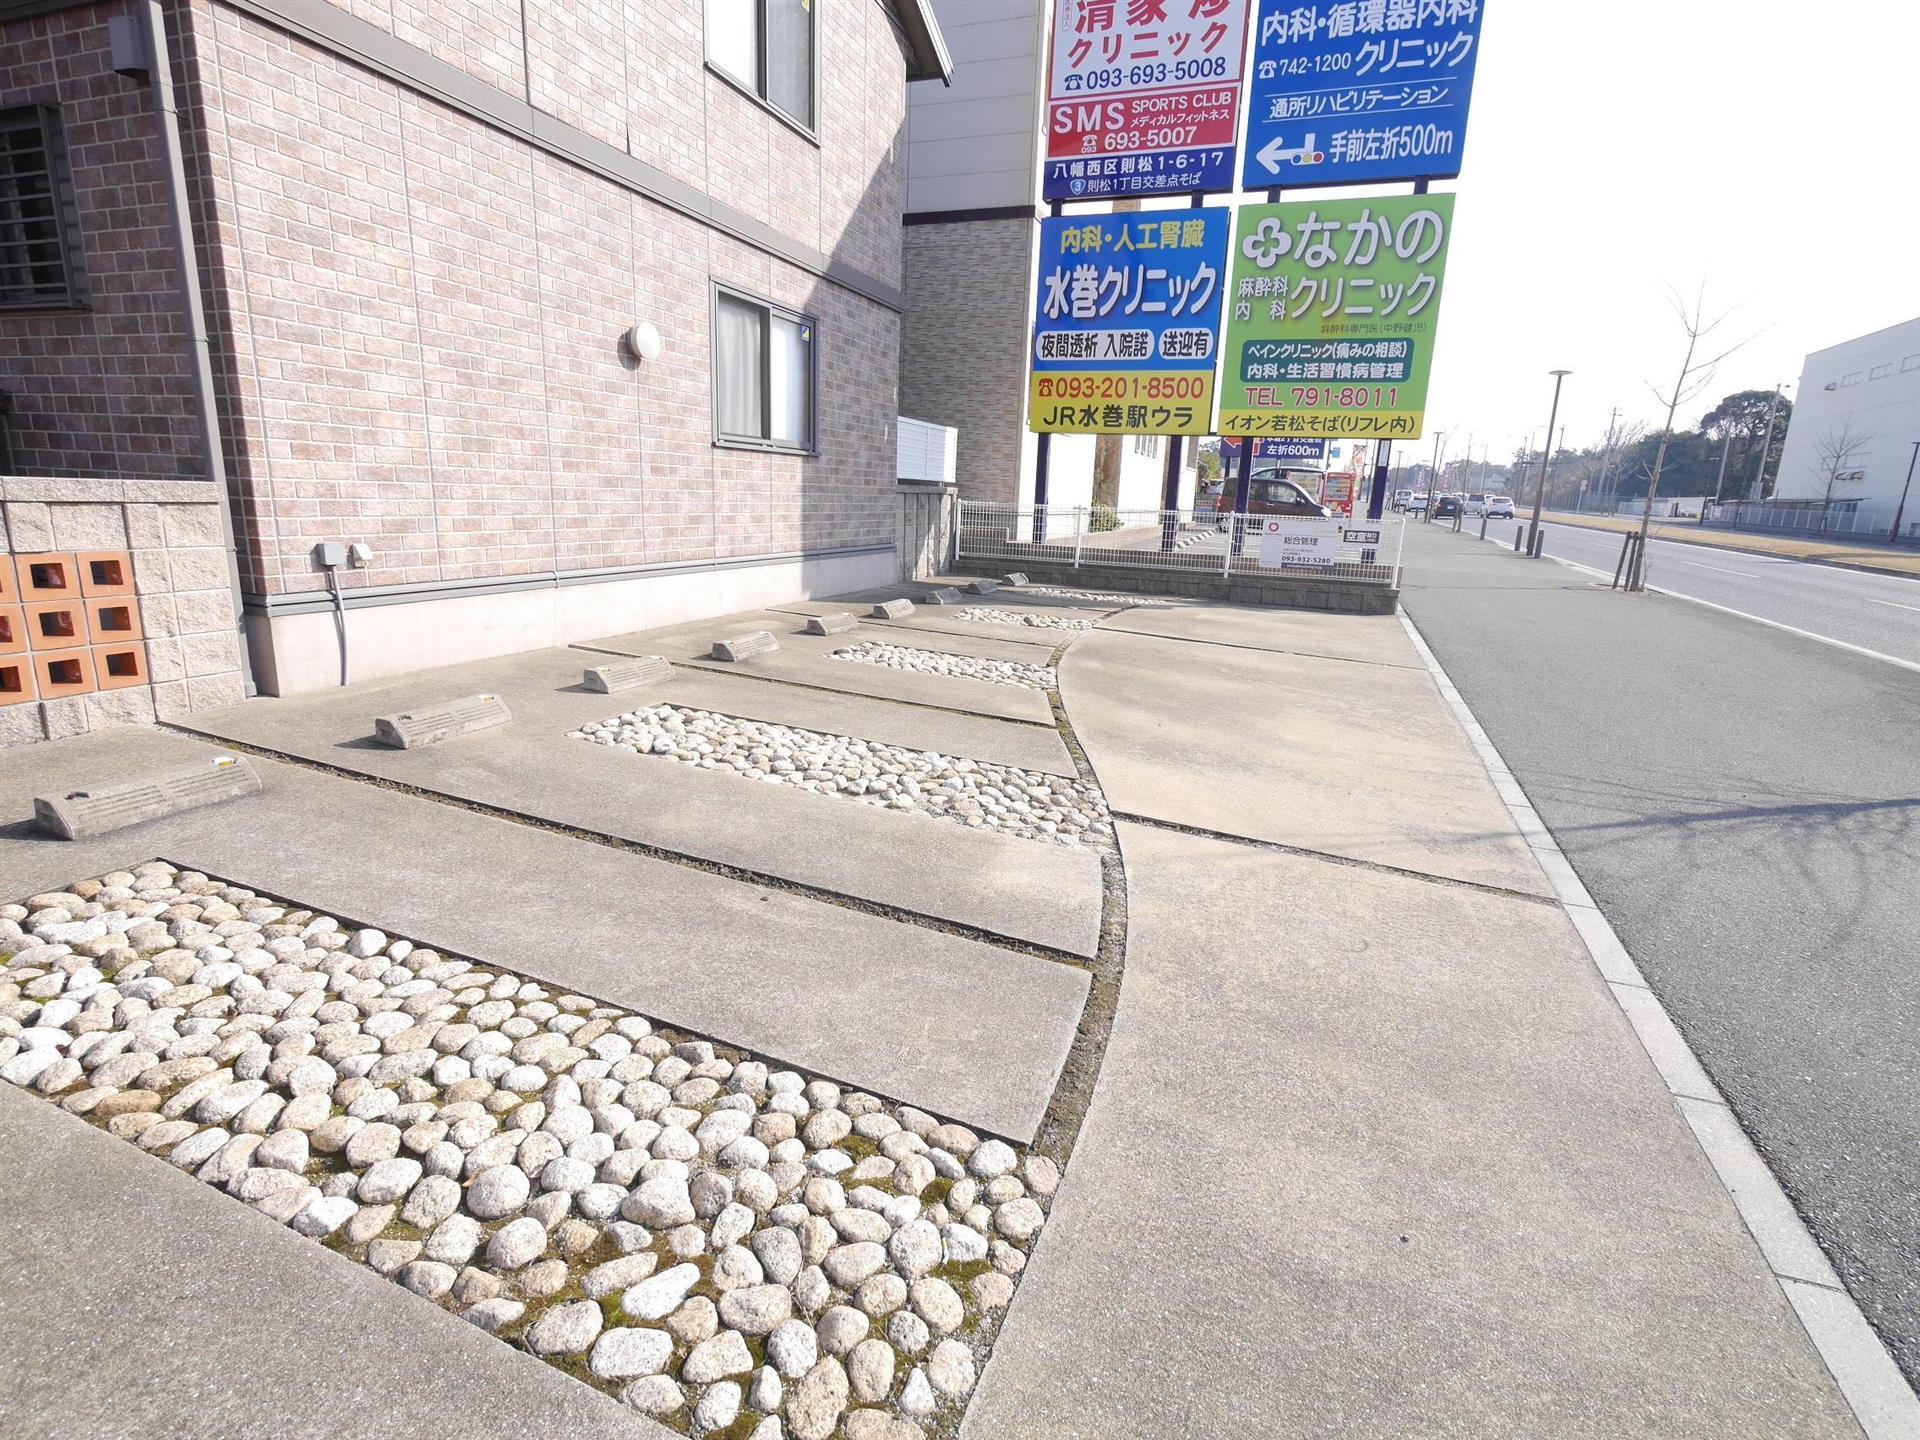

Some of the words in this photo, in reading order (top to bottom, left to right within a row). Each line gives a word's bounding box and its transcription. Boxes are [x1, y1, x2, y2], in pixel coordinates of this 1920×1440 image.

[1261, 0, 1478, 46] 内科・循環器内科
[1068, 22, 1229, 68] クリニック
[1279, 52, 1351, 75] 742-1200
[1355, 31, 1473, 76] クリニック
[1087, 57, 1226, 89] 093-693-5008
[1131, 96, 1187, 113] SPORTS
[1193, 92, 1232, 107] CLUB
[1269, 85, 1449, 119] 通所リハビリテーション
[1054, 103, 1125, 134] SMS
[1130, 109, 1230, 128] メディカルフィットネス
[1104, 126, 1197, 150] 693-5007
[1330, 123, 1453, 163] 手前左折500m
[1087, 171, 1202, 192] 則松1丁目交差点そば
[1060, 219, 1205, 254] 内科・人工腎臓
[1293, 209, 1443, 268] なかの
[1043, 261, 1216, 319] 水巻クリニック
[1237, 275, 1288, 297] 麻酔科
[1291, 273, 1436, 318] クリニック
[1042, 333, 1098, 358] 夜間透析
[1162, 330, 1209, 357] 送迎有
[1247, 362, 1404, 379] 内科・生活習慣病管理
[1055, 377, 1204, 399] 093-201-8500
[1245, 387, 1283, 406] TEL
[1291, 387, 1398, 407] 791-8011
[1043, 404, 1193, 428] JR水巻駅ウラ
[1225, 415, 1415, 433] イオン若松そば(リフレ内)
[1267, 444, 1320, 456] 左折600m
